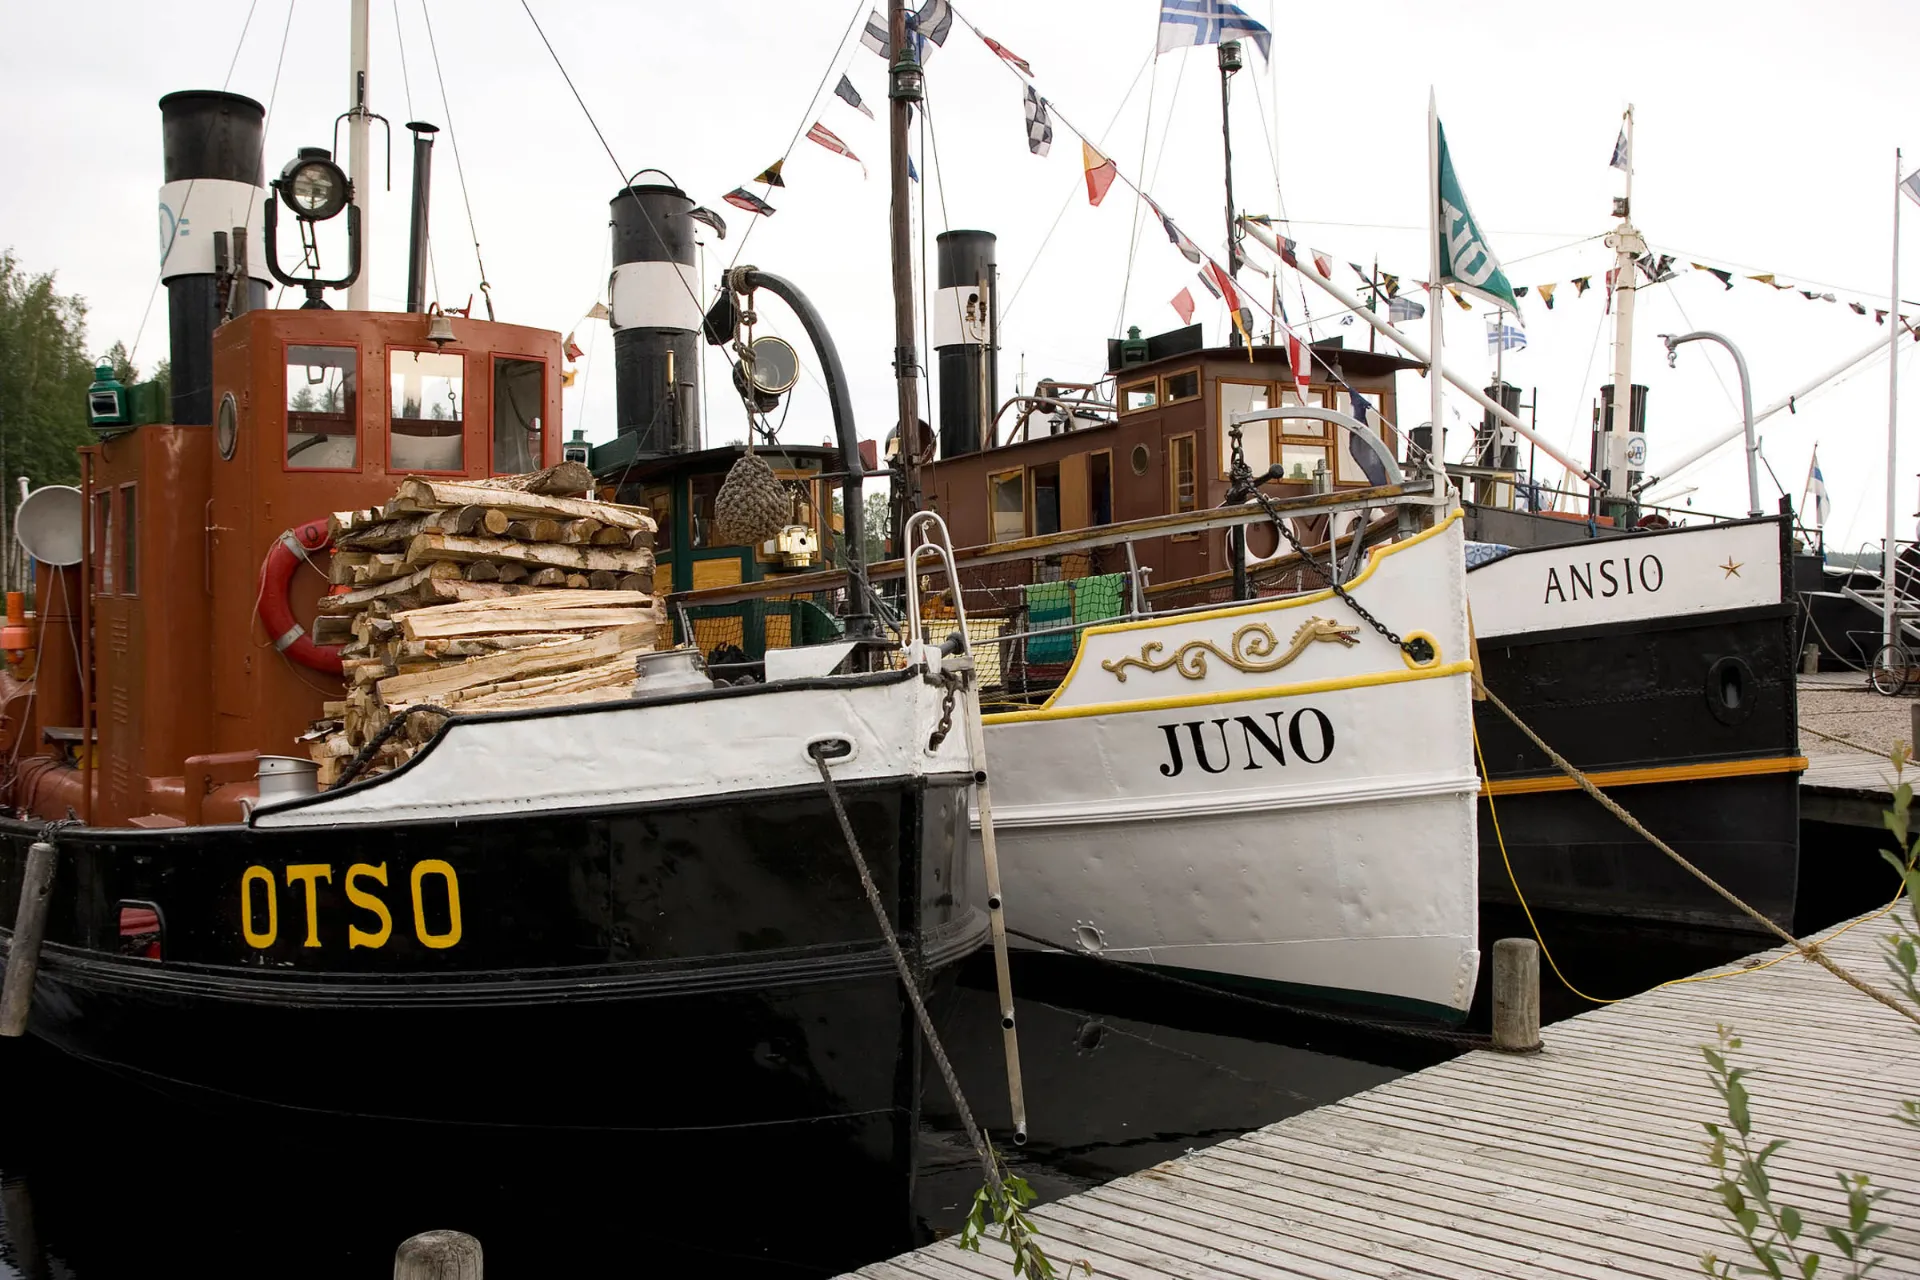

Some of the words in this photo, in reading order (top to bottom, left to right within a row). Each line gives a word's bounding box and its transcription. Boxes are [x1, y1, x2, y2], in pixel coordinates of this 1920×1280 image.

[1544, 554, 1664, 604] ANSIO
[1157, 707, 1336, 778] JUNO
[240, 859, 463, 950] OTSO
